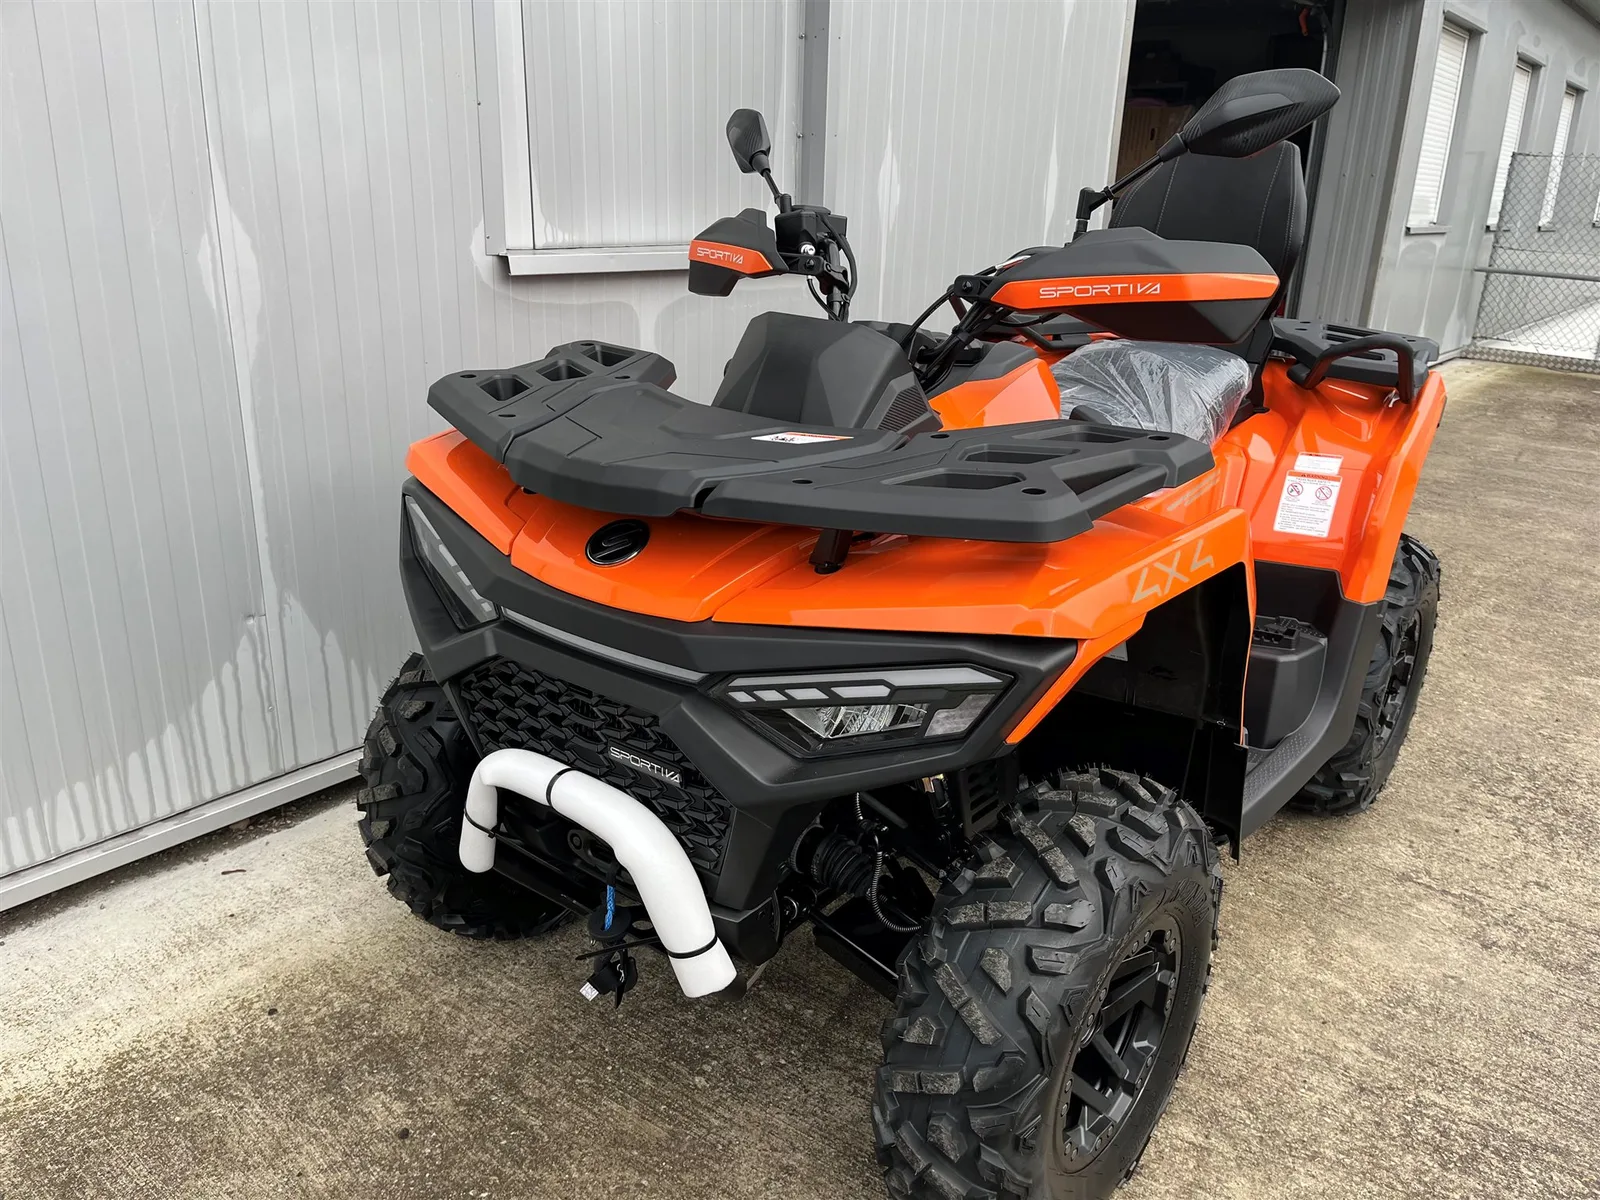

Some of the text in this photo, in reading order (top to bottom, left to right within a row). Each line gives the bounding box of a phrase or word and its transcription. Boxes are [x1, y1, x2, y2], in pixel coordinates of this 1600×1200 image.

[697, 247, 744, 264] SPORTIVA
[1039, 282, 1161, 299] SPORTIVA
[609, 746, 681, 784] SPORTIVA
